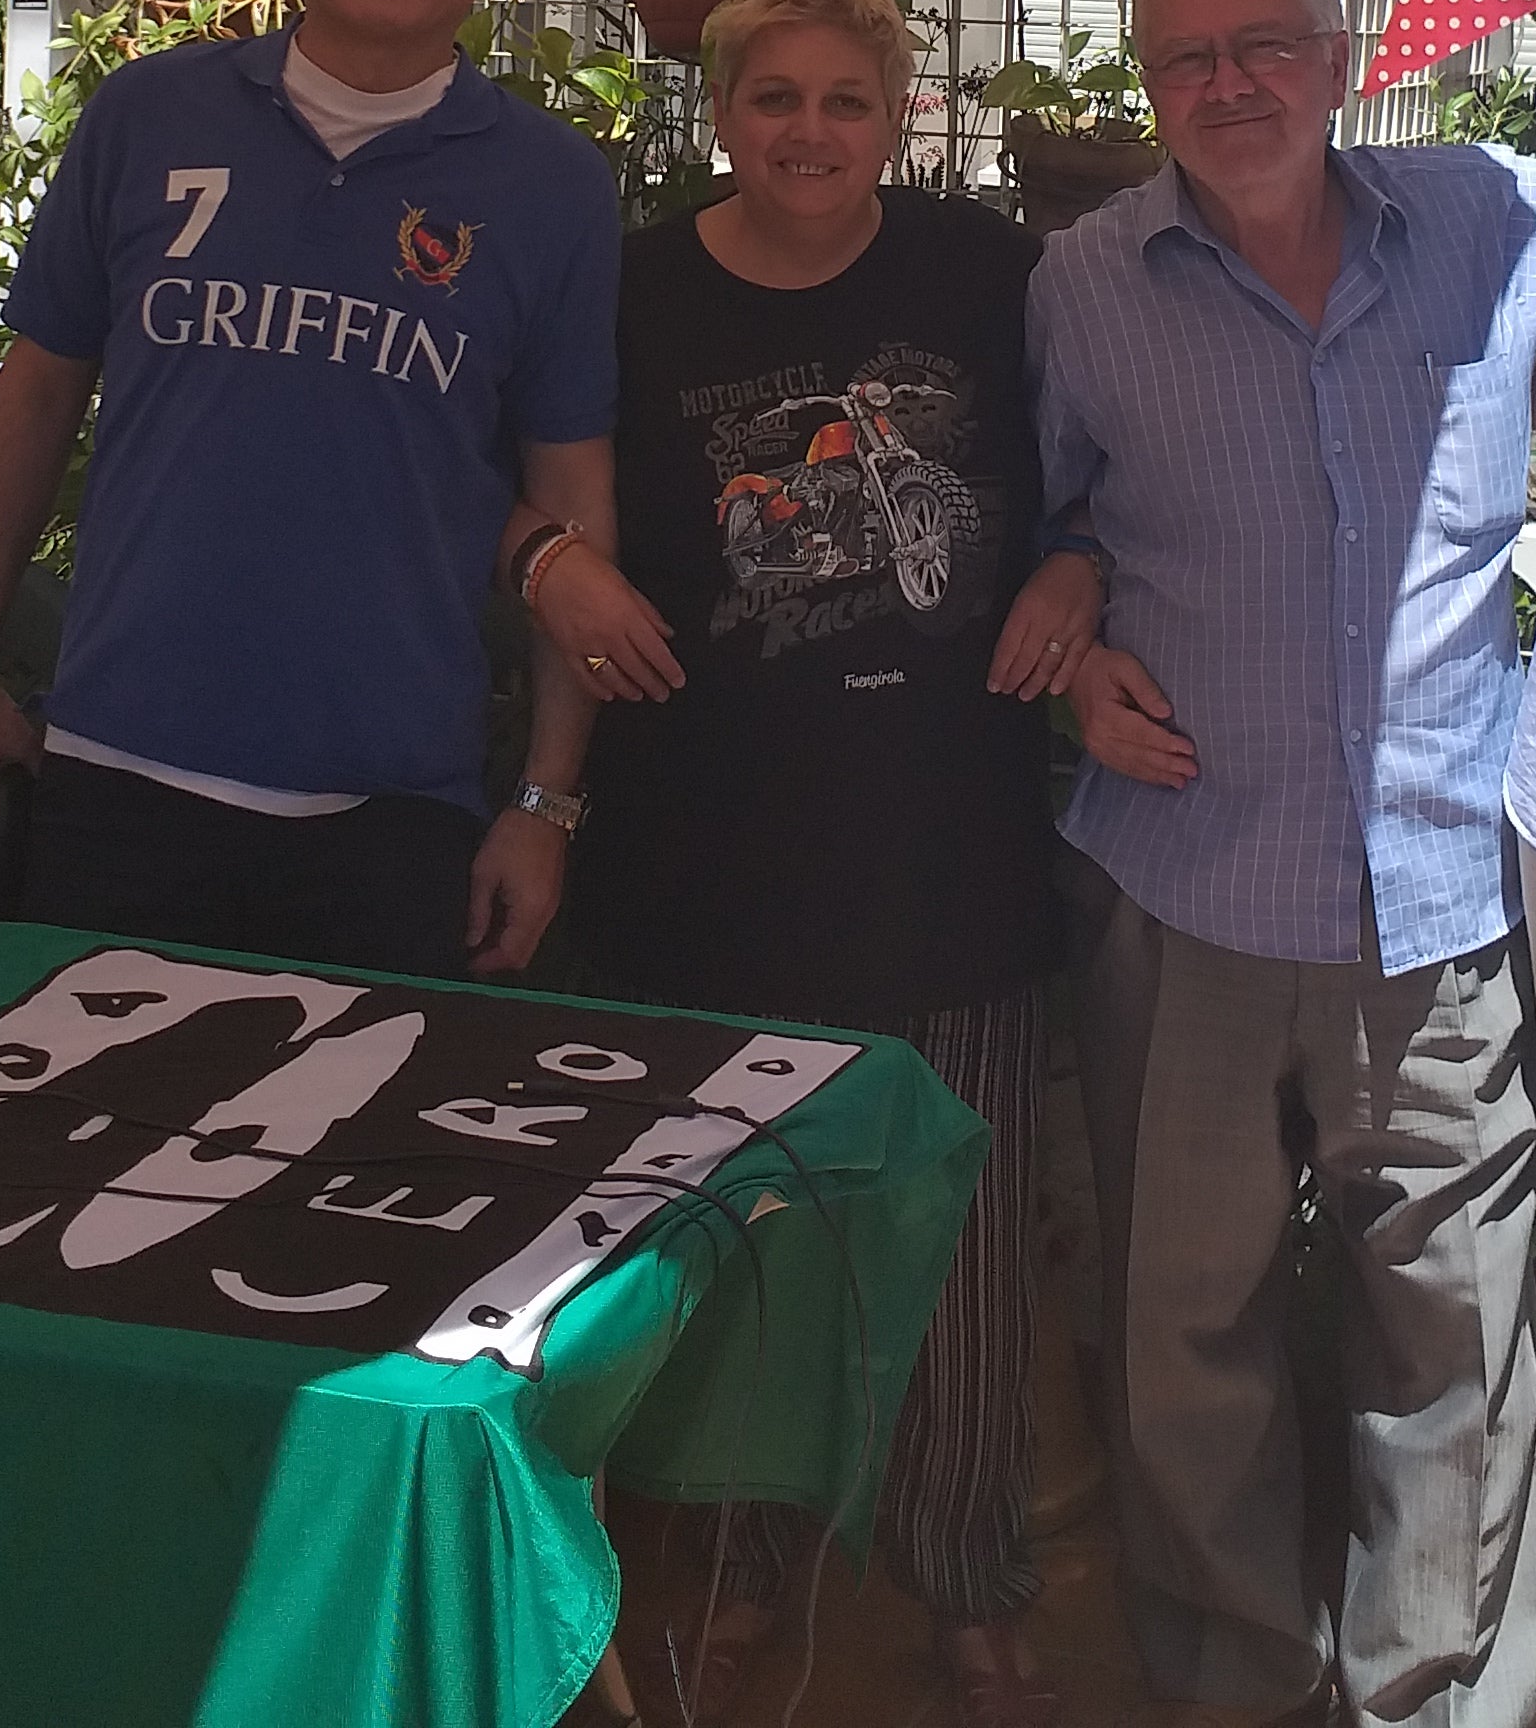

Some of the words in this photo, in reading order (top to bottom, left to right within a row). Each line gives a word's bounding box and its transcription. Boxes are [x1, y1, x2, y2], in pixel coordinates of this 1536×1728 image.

[166, 167, 231, 259] 7
[143, 277, 470, 394] GRIFFIN
[844, 667, 906, 690] Fuengirola
